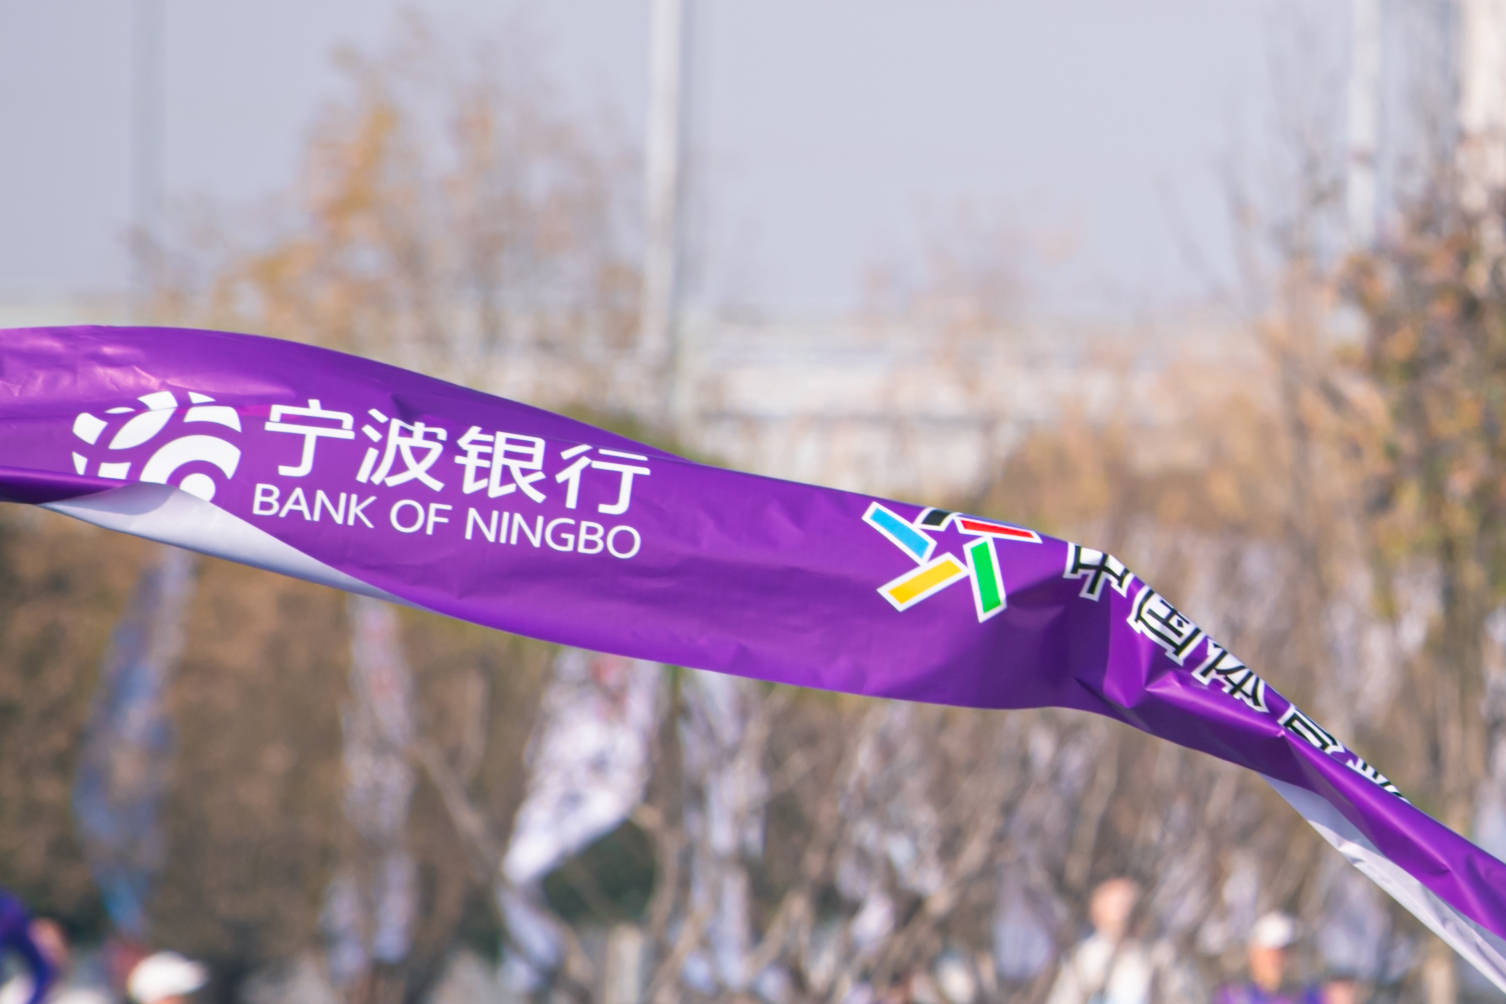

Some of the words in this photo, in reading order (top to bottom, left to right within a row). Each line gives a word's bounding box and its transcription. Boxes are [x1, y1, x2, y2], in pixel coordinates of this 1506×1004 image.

[264, 398, 651, 515] 宁波银行
[252, 483, 378, 529] BANK
[390, 499, 453, 536] OF
[465, 507, 642, 559] NINGBO
[1062, 541, 1409, 803] 中国体
